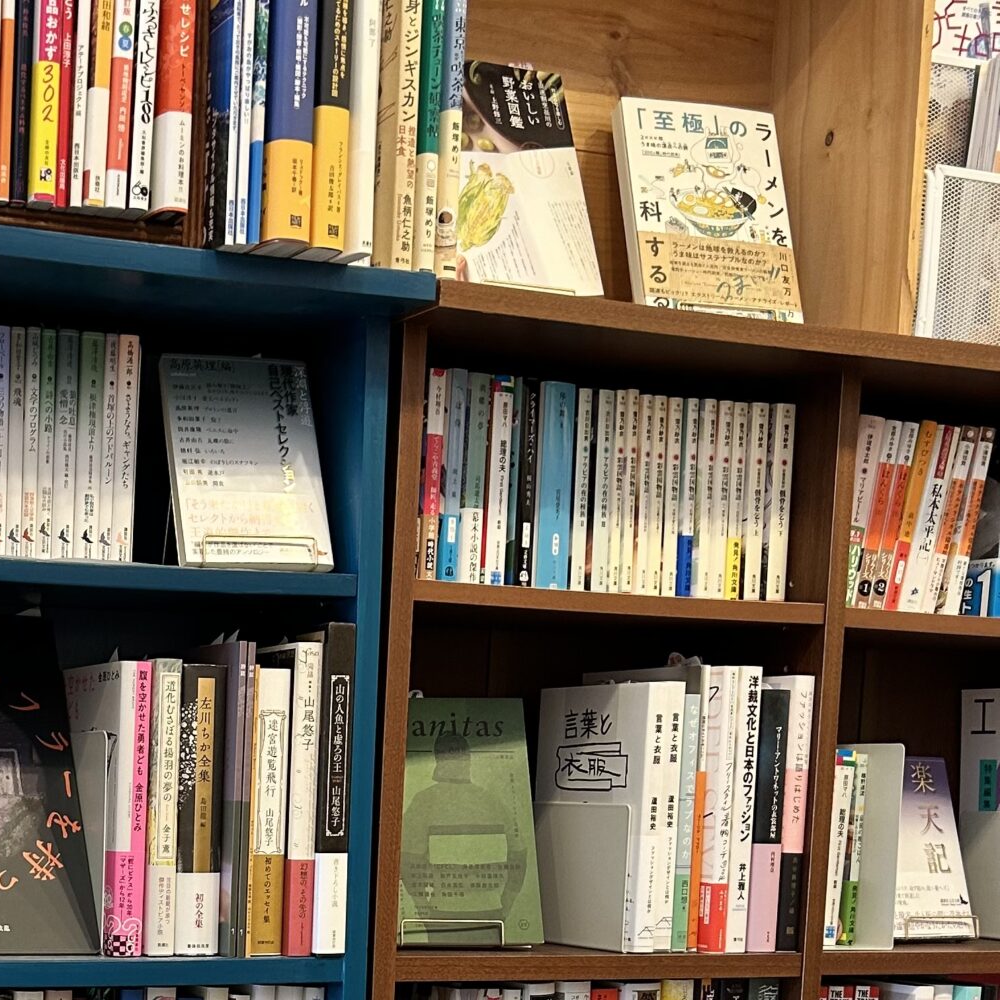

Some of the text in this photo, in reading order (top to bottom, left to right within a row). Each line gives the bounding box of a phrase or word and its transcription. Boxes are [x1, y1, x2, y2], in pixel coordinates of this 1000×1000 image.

[42, 64, 54, 123] 302
[502, 76, 525, 130] 野菜図鑑
[451, 122, 460, 165] 飯塚めり
[755, 123, 787, 247] ラーメンを
[424, 196, 434, 238] 飯塚めり
[779, 253, 791, 296] 川口友万
[136, 670, 148, 776] 腹を空かせた勇者ども
[198, 698, 211, 782] 左川ちか全集
[303, 696, 314, 751] 山尾悠子
[333, 685, 345, 773] 山の人魚と虚ろの王
[565, 709, 613, 739] 言葉と
[265, 720, 278, 798] 迷宮遊覧飛行
[561, 757, 621, 777] 衣服
[741, 676, 759, 843] 洋裁文化と日本のファッション
[134, 782, 143, 832] 金原ひとみ
[265, 808, 273, 846] 山尾悠子
[331, 786, 340, 827] 山尾悠子
[911, 762, 951, 874] 楽天記
[195, 893, 204, 928] 初の全集
[831, 990, 842, 998] THE
